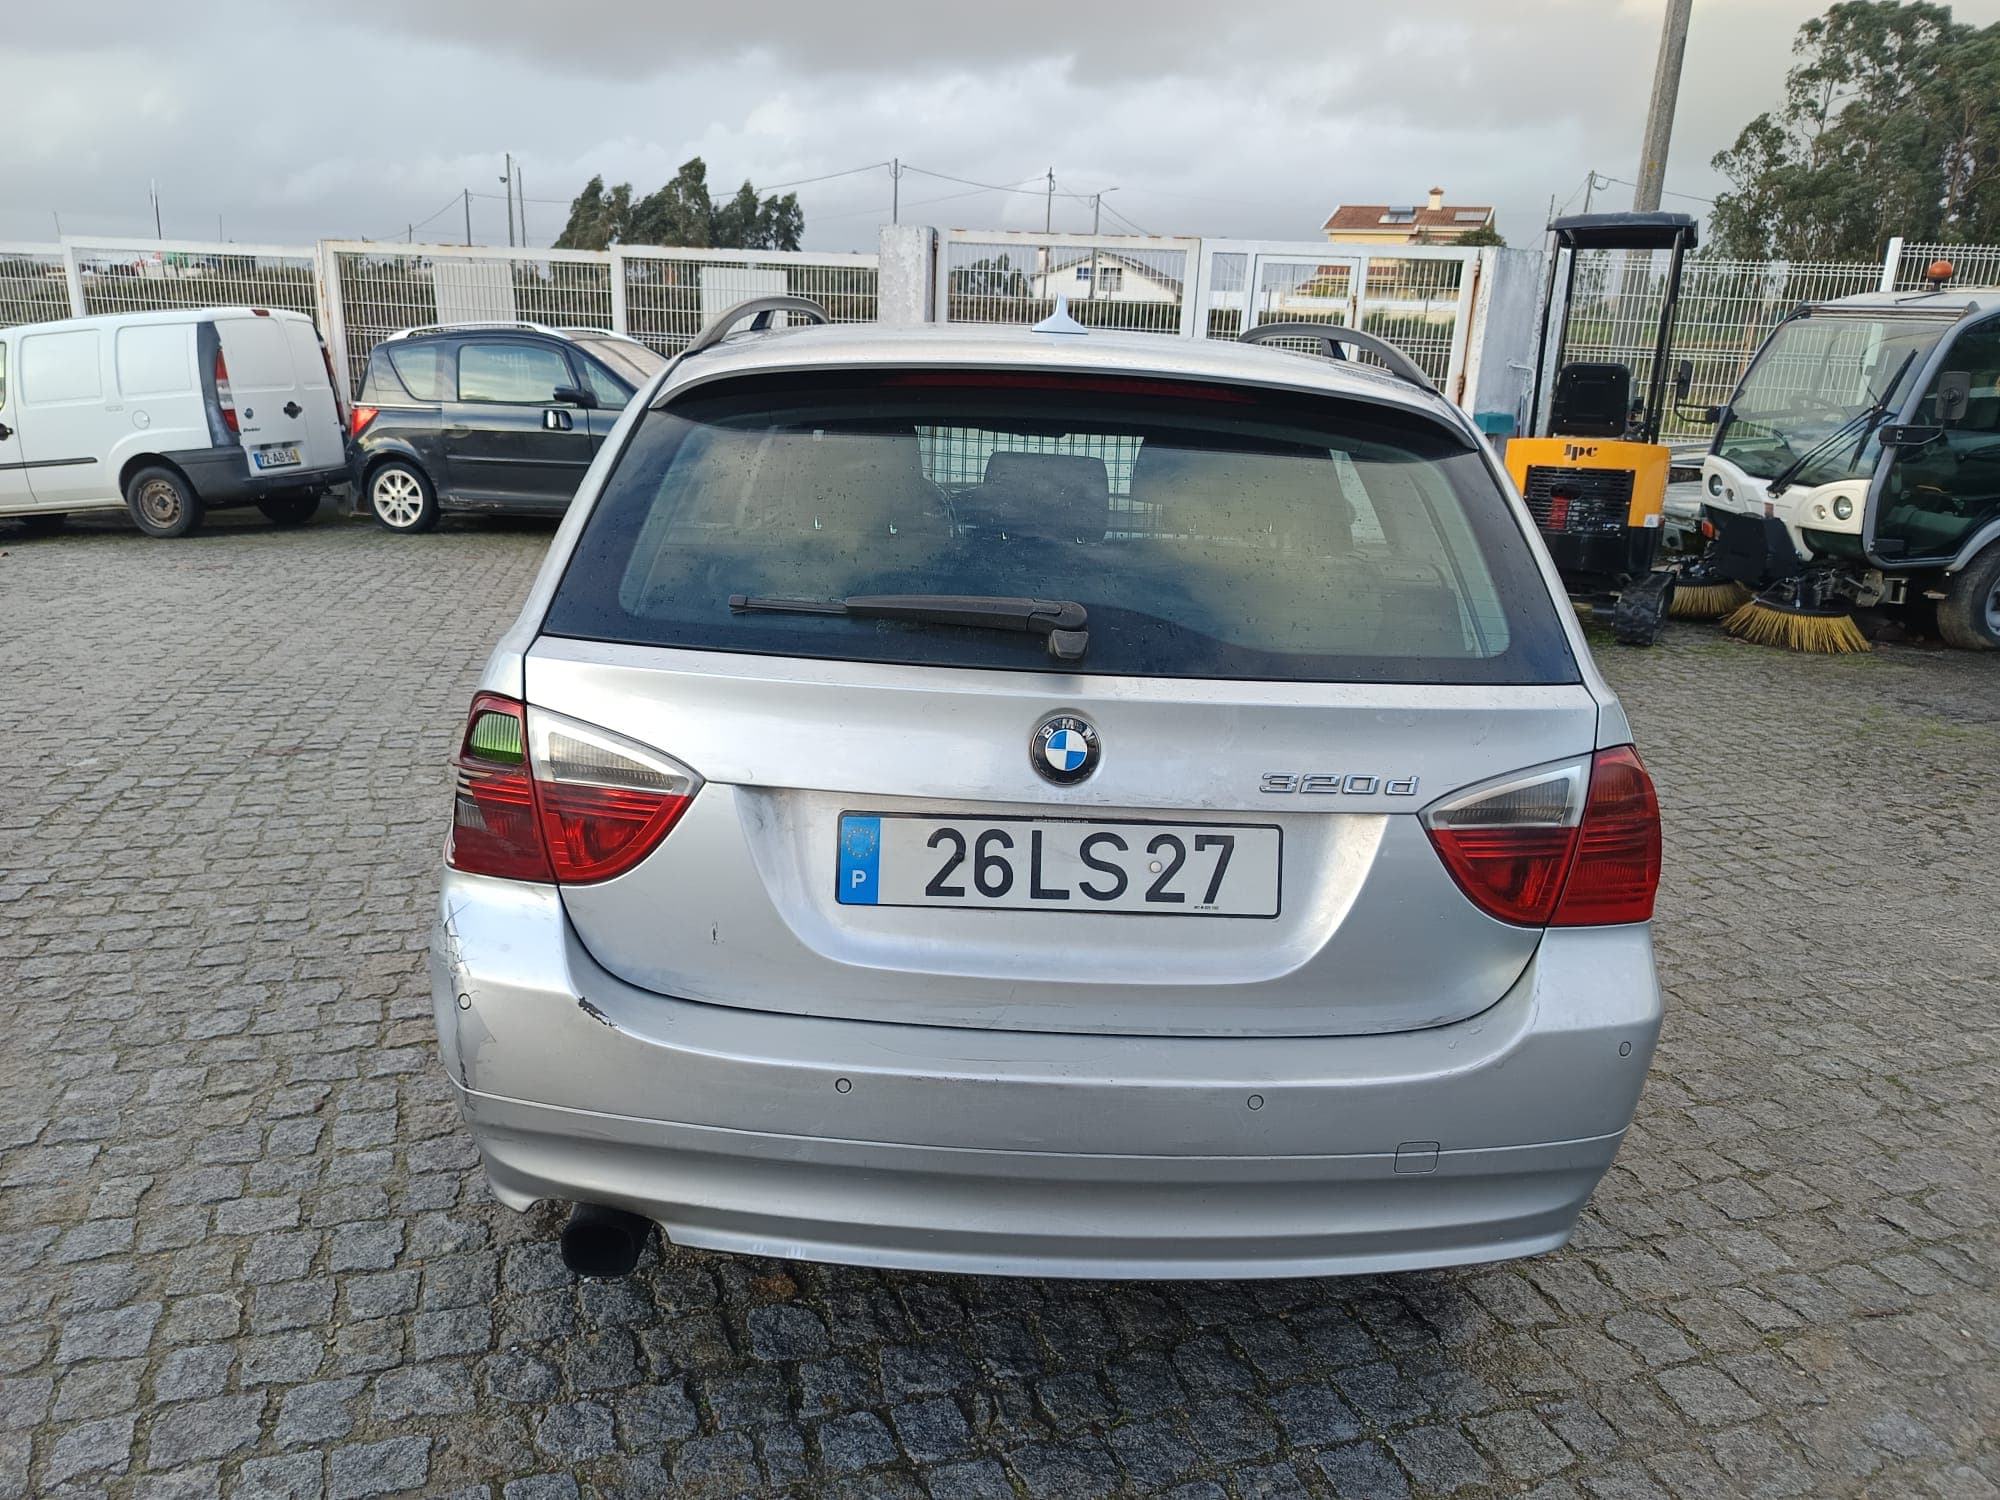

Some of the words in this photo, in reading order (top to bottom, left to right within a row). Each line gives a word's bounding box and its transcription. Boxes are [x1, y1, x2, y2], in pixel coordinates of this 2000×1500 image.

[1039, 718, 1096, 741] BMW
[1259, 773, 1421, 796] 320d
[851, 869, 867, 889] P
